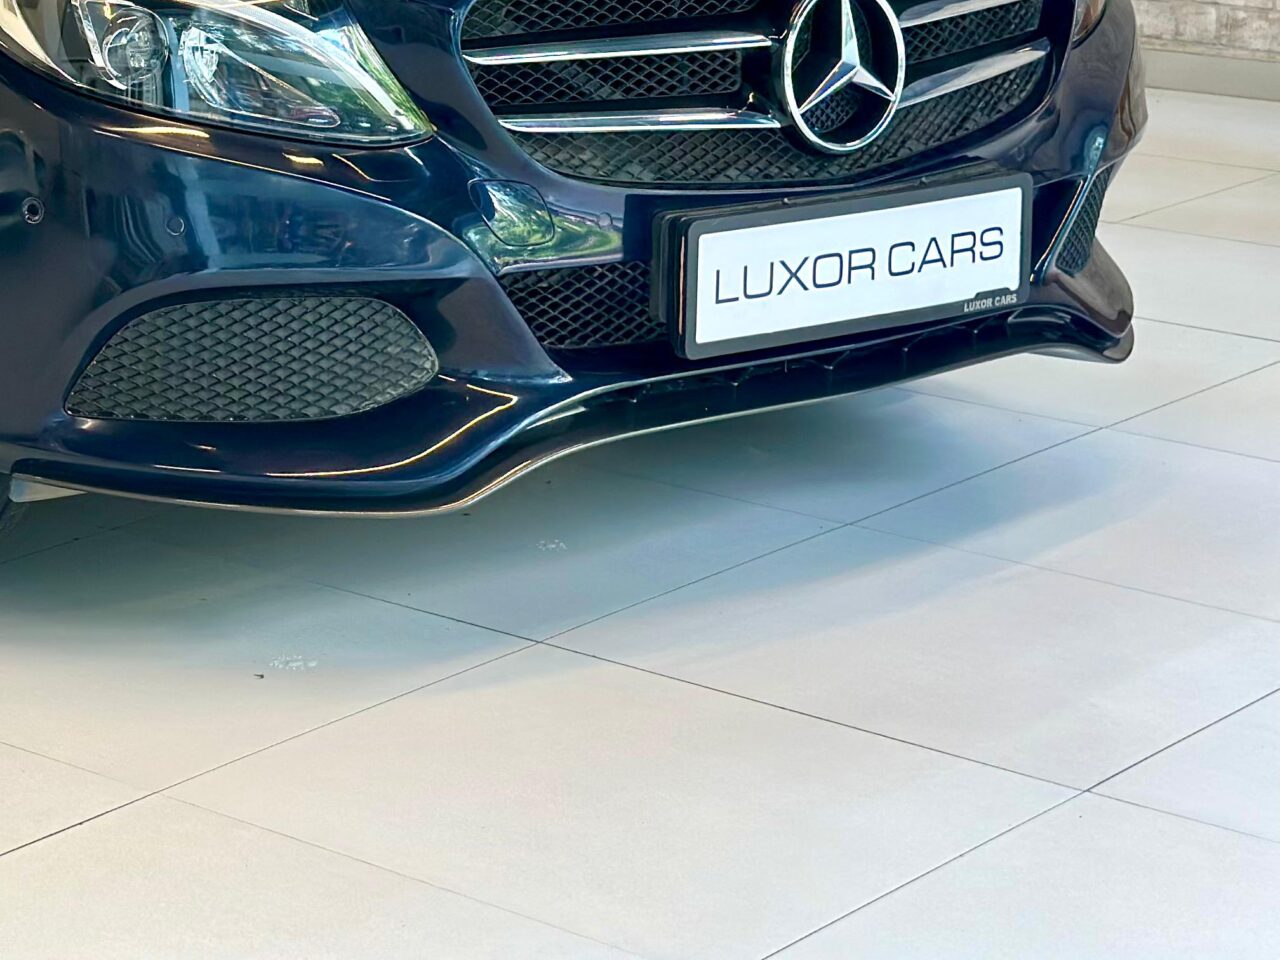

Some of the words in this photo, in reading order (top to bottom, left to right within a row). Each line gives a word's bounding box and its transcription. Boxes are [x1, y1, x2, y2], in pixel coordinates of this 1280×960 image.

[714, 247, 876, 304] LUXOR
[888, 227, 1003, 275] CARS
[963, 298, 993, 312] LUXOR
[994, 293, 1017, 306] CARS
